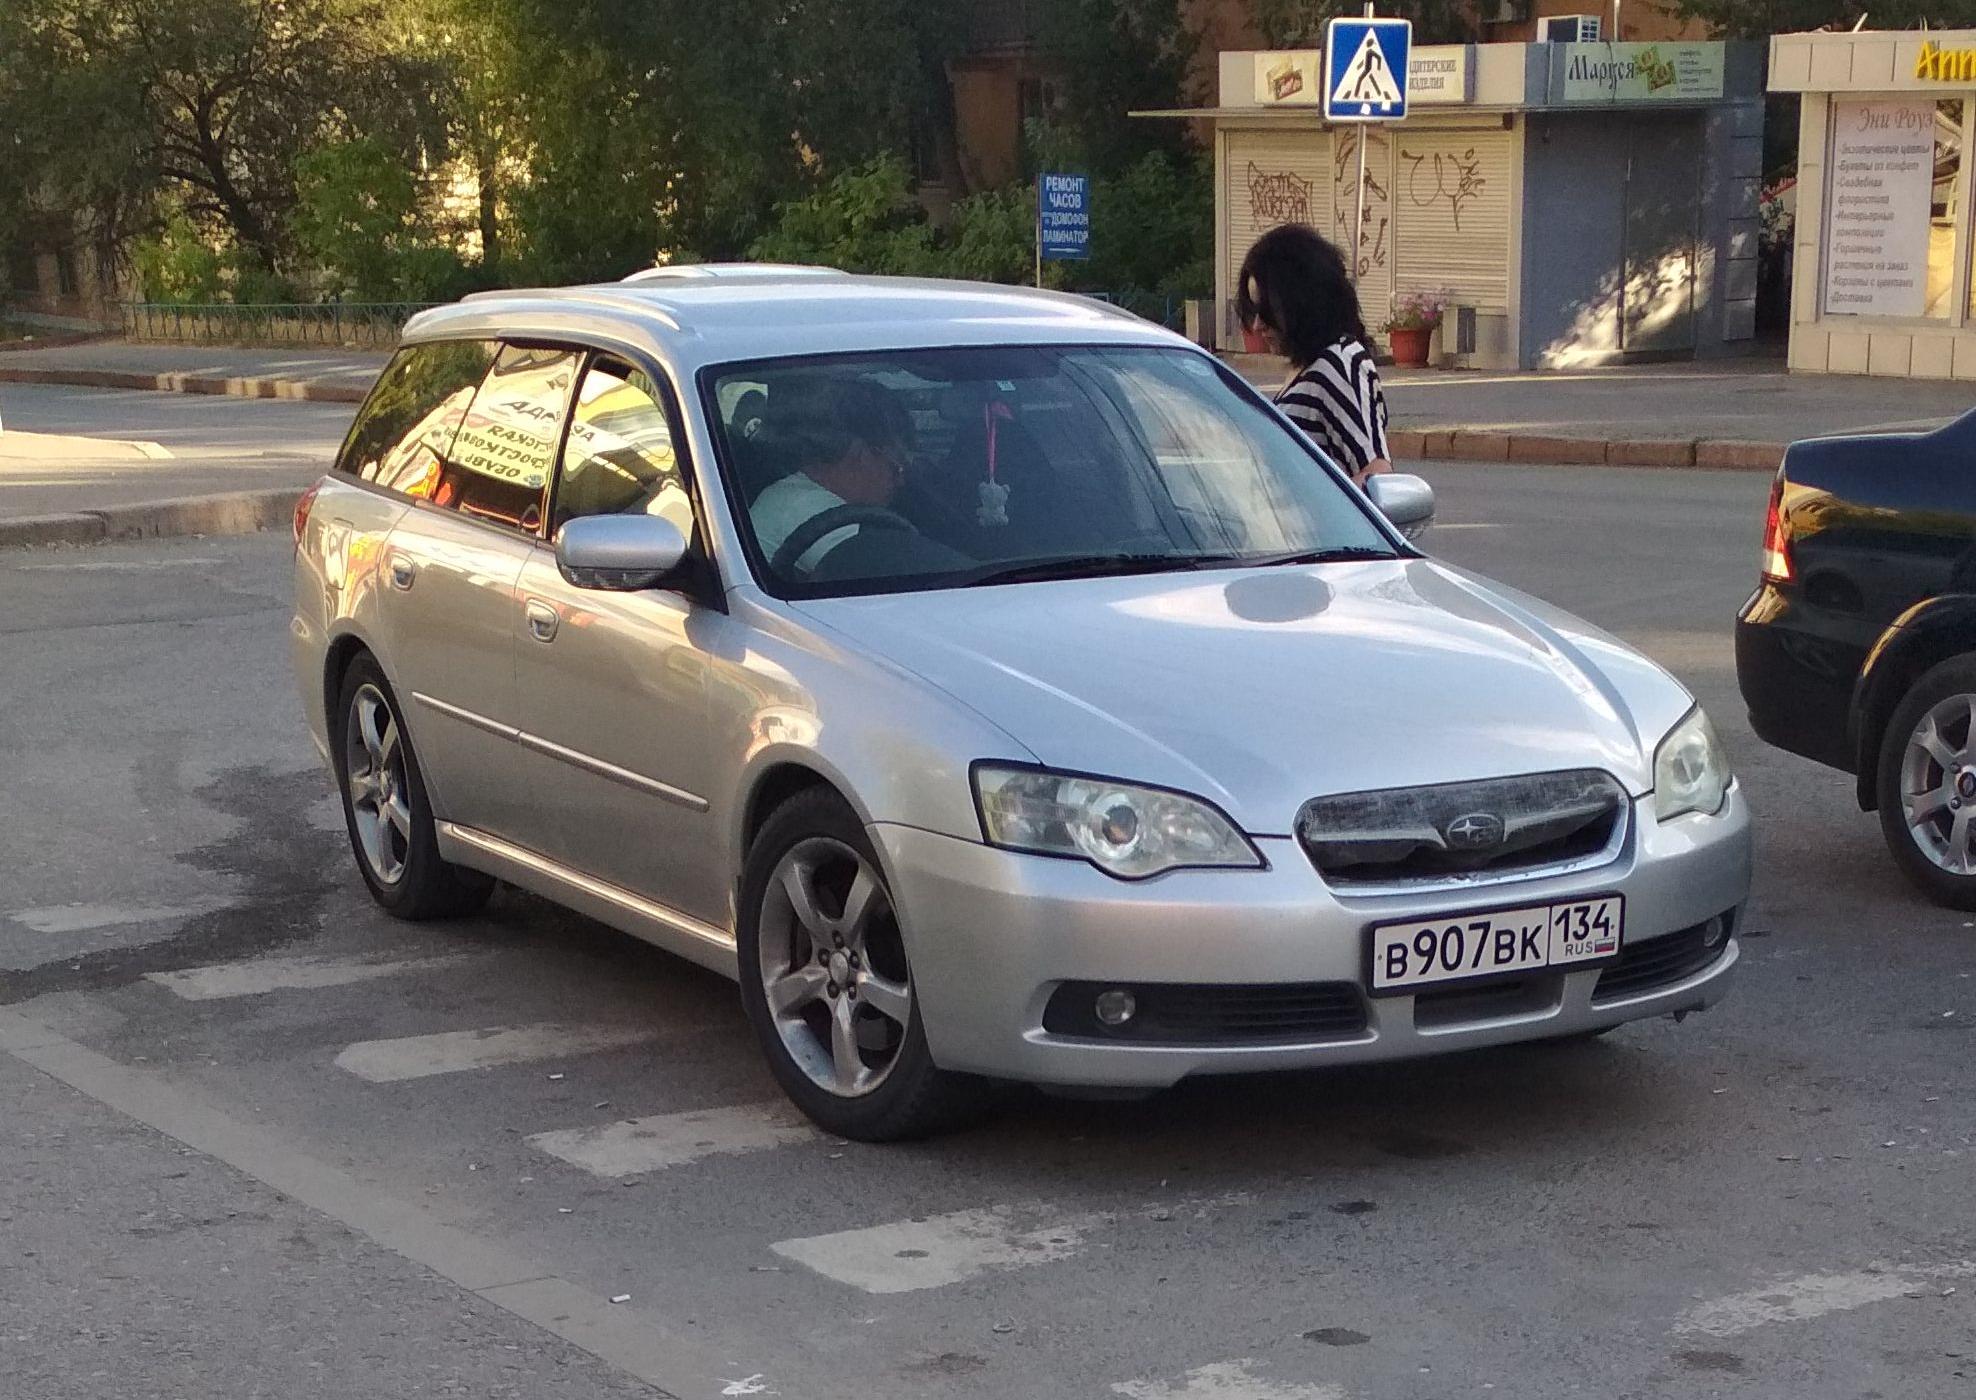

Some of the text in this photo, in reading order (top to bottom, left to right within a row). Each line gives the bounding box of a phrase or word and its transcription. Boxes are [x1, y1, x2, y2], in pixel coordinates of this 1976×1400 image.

[1409, 59, 1456, 73] ДИТЕРСКИЕ
[1569, 55, 1635, 89] Маруся
[1857, 107, 1890, 132] Эни
[1046, 176, 1085, 192] РЕМОНТ
[1049, 192, 1082, 208] ЧАСОВ
[1043, 230, 1089, 244] ЛАМИНАТОР
[1554, 903, 1611, 943] 134
[1565, 940, 1594, 957] RUS
